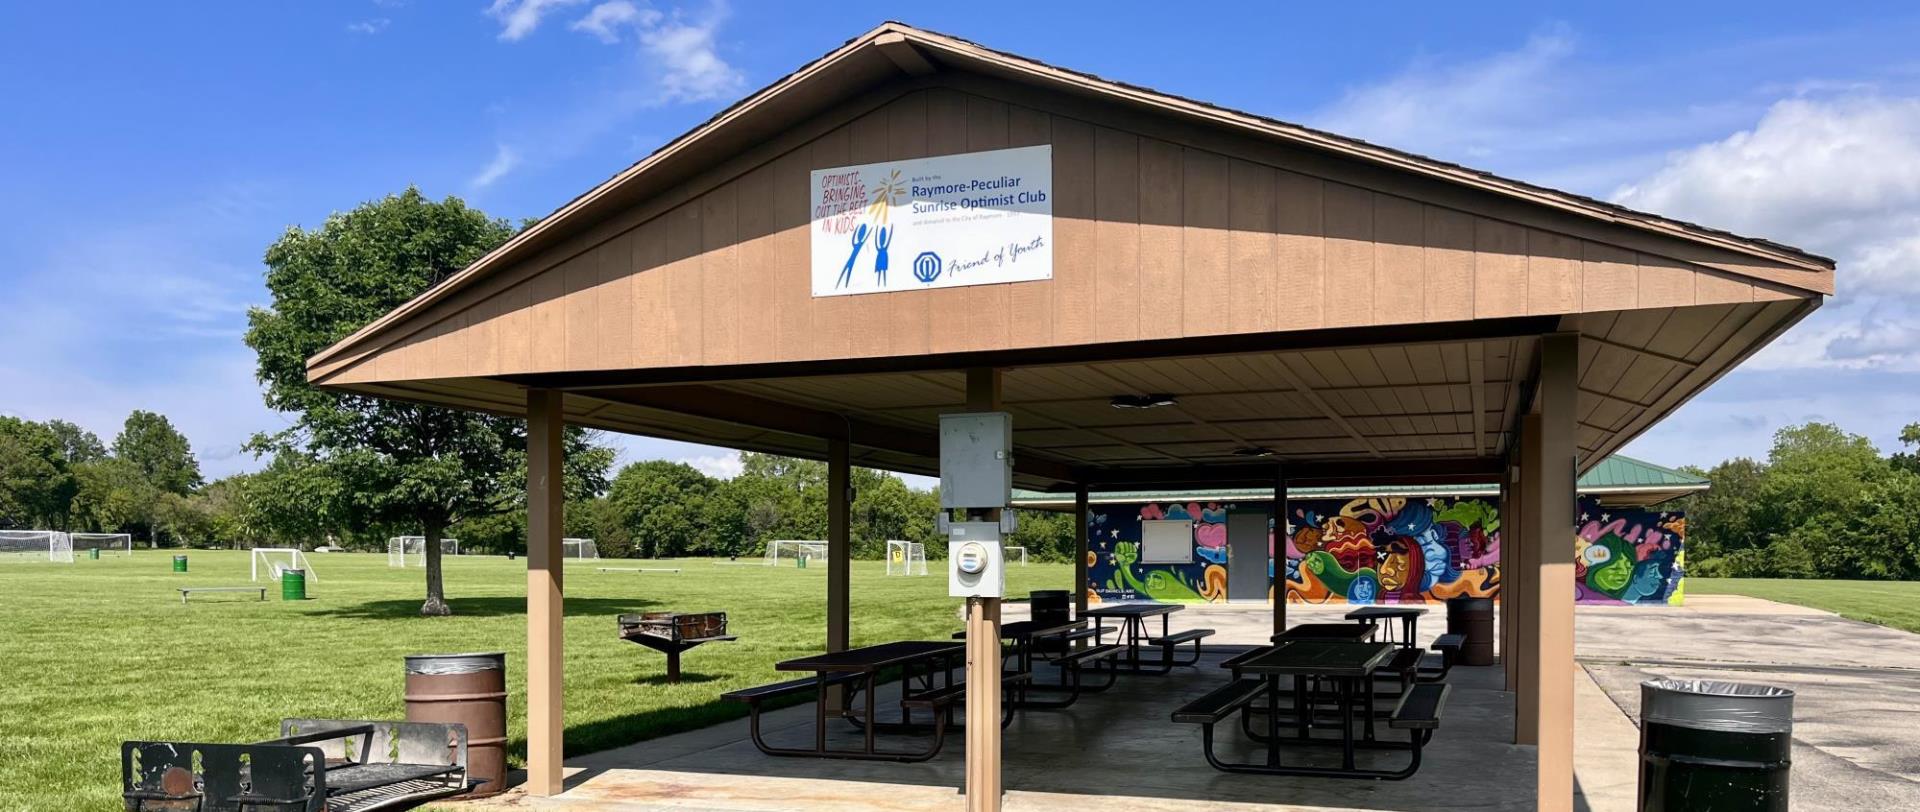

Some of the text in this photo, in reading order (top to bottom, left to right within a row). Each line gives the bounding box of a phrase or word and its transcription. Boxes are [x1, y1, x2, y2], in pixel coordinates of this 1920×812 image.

[822, 185, 866, 205] BRINGING
[912, 176, 1021, 198] Raymore-Peculiar
[815, 199, 868, 219] OUT THE BEST
[912, 189, 1046, 214] Sunrise Optimist Club
[822, 215, 857, 235] IN KIDS
[947, 235, 1045, 278] Friend of Youth
